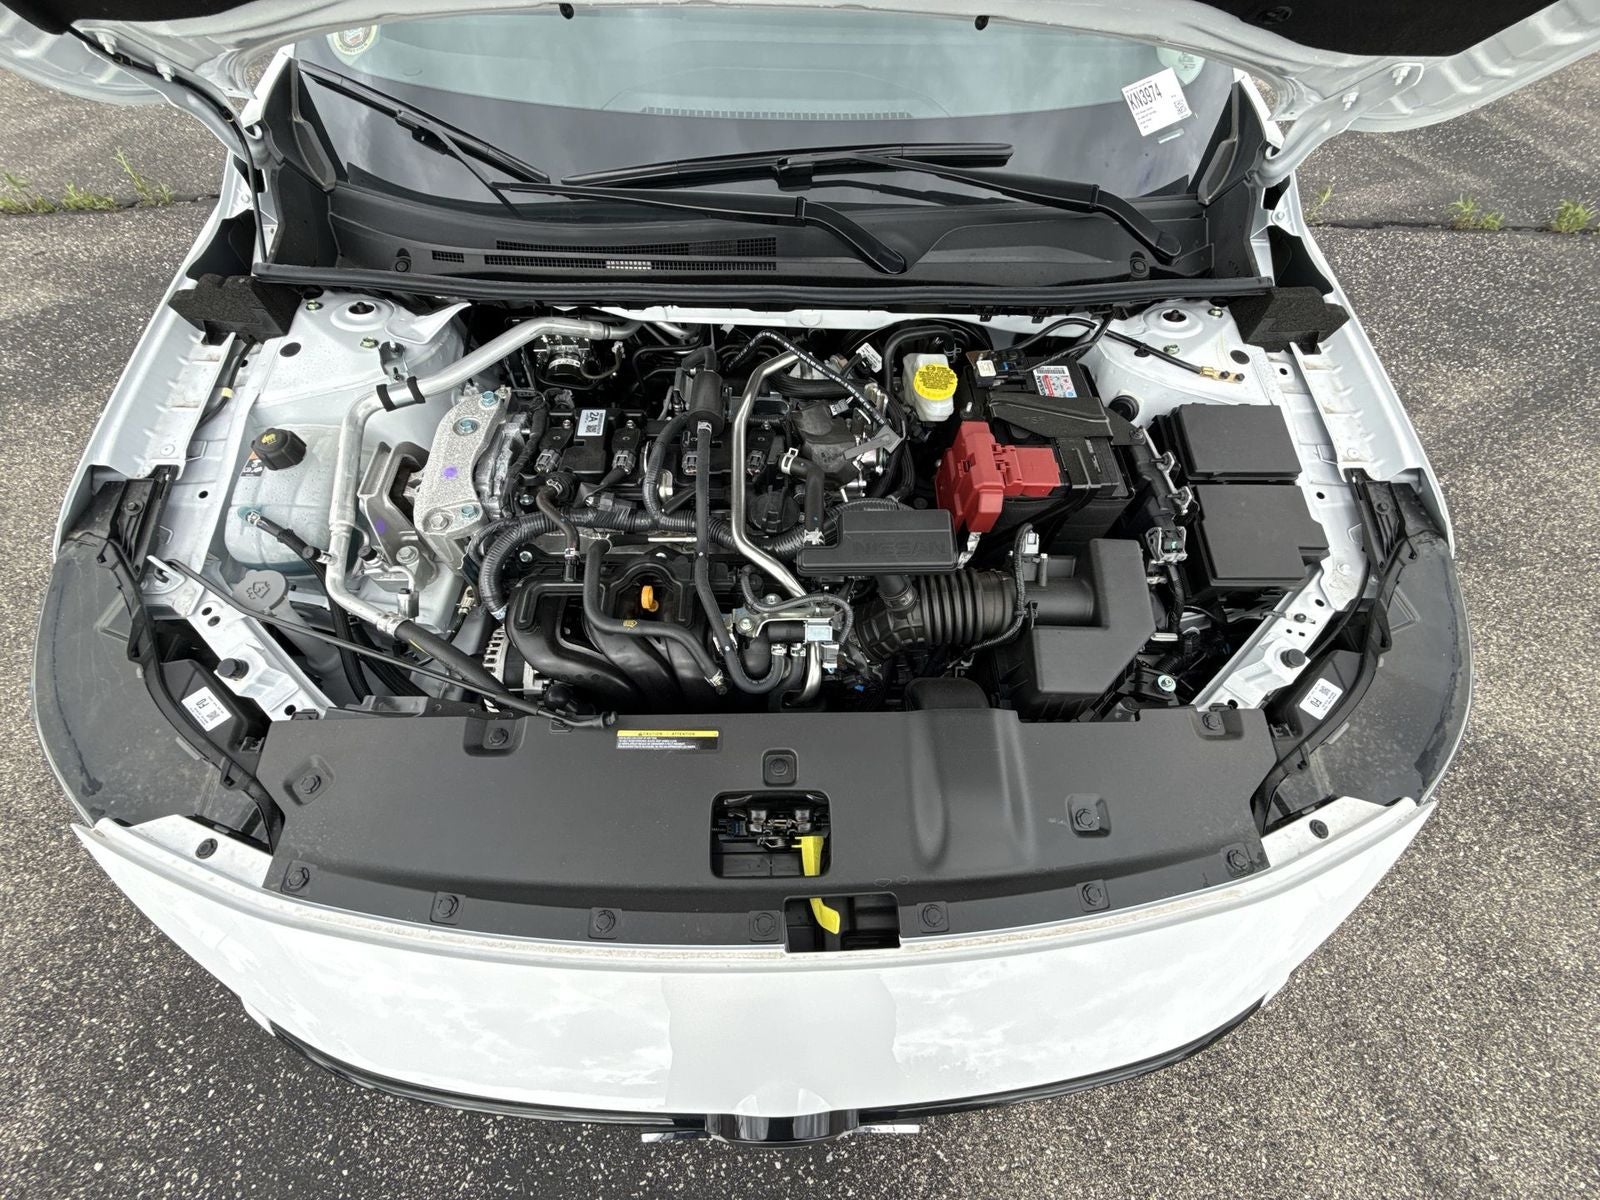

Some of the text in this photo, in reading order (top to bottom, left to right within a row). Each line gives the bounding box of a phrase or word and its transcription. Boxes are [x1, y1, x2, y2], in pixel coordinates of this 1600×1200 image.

[1127, 83, 1162, 111] KN3974
[589, 411, 599, 422] 2A
[854, 541, 946, 554] NISSAN
